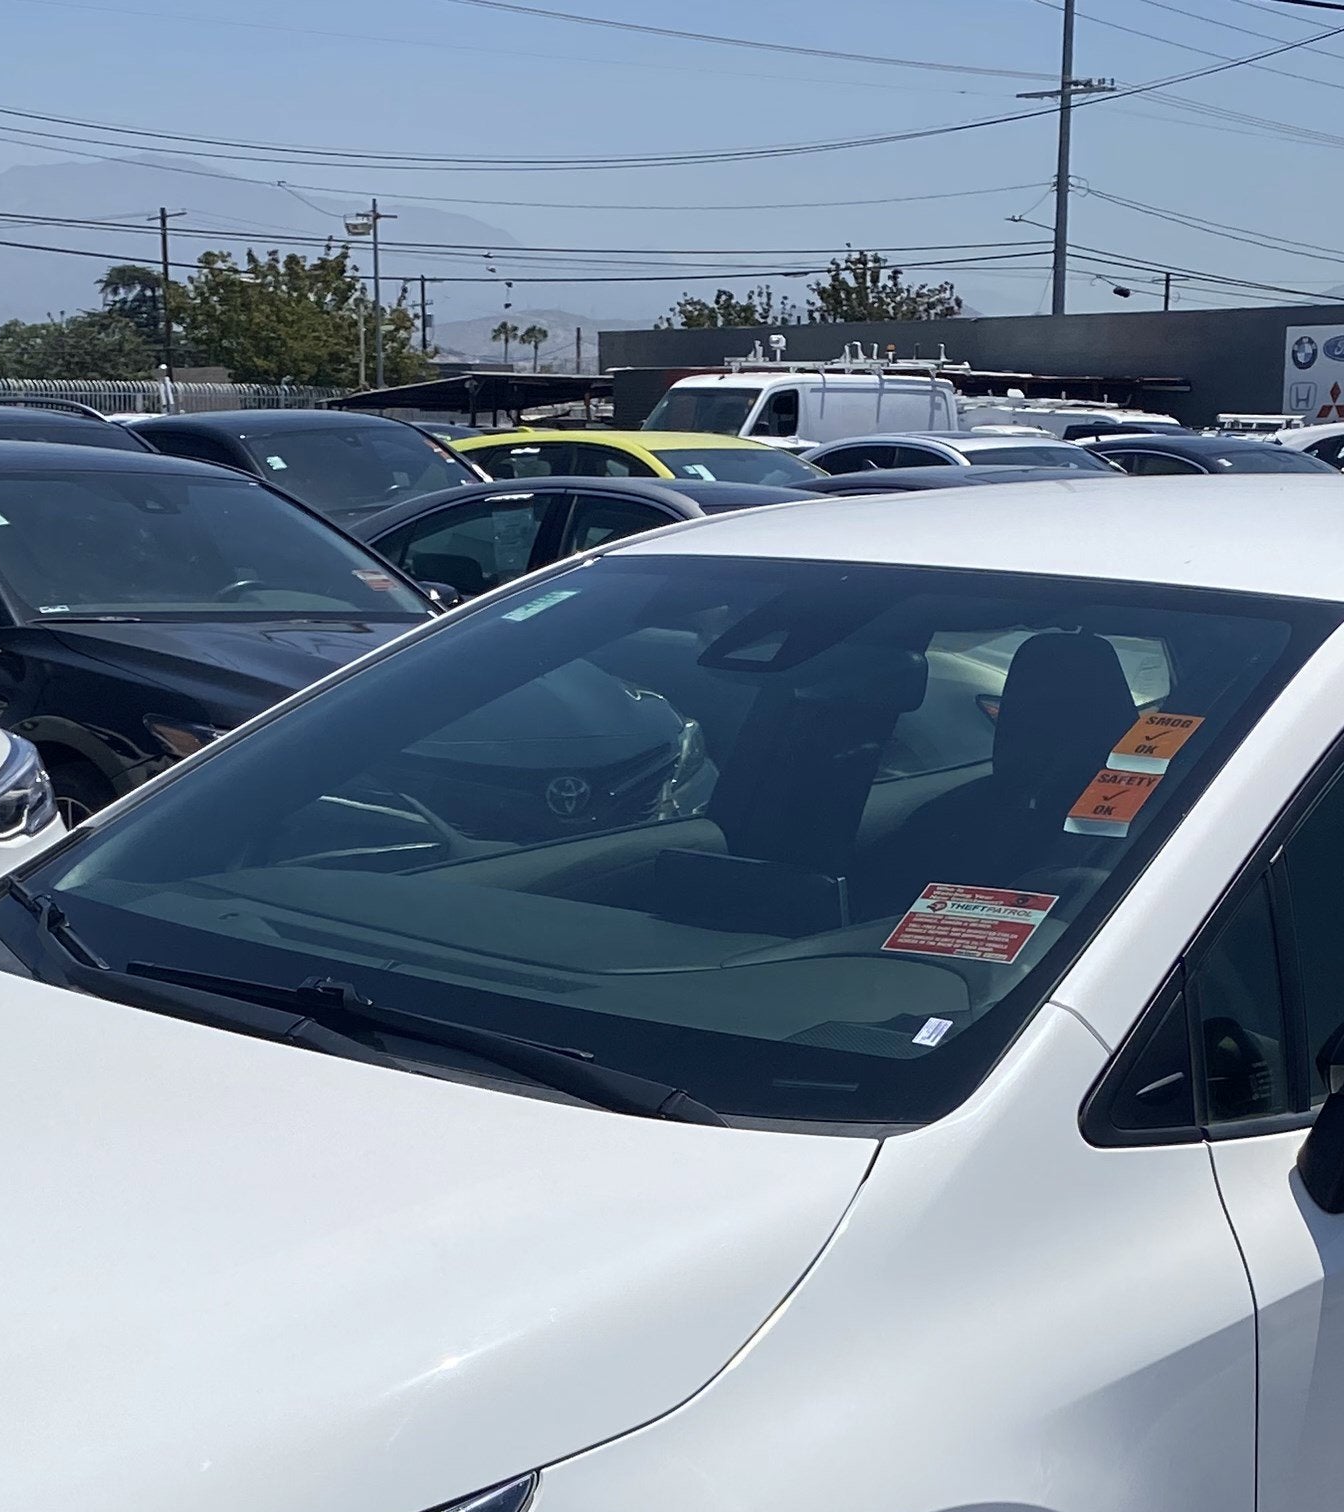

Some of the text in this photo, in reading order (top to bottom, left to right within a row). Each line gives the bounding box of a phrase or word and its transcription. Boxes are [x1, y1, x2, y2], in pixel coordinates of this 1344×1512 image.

[1146, 716, 1194, 728] SMOG
[1135, 744, 1159, 754] OK
[1097, 773, 1156, 787] SAFETY
[1092, 805, 1116, 816] OK
